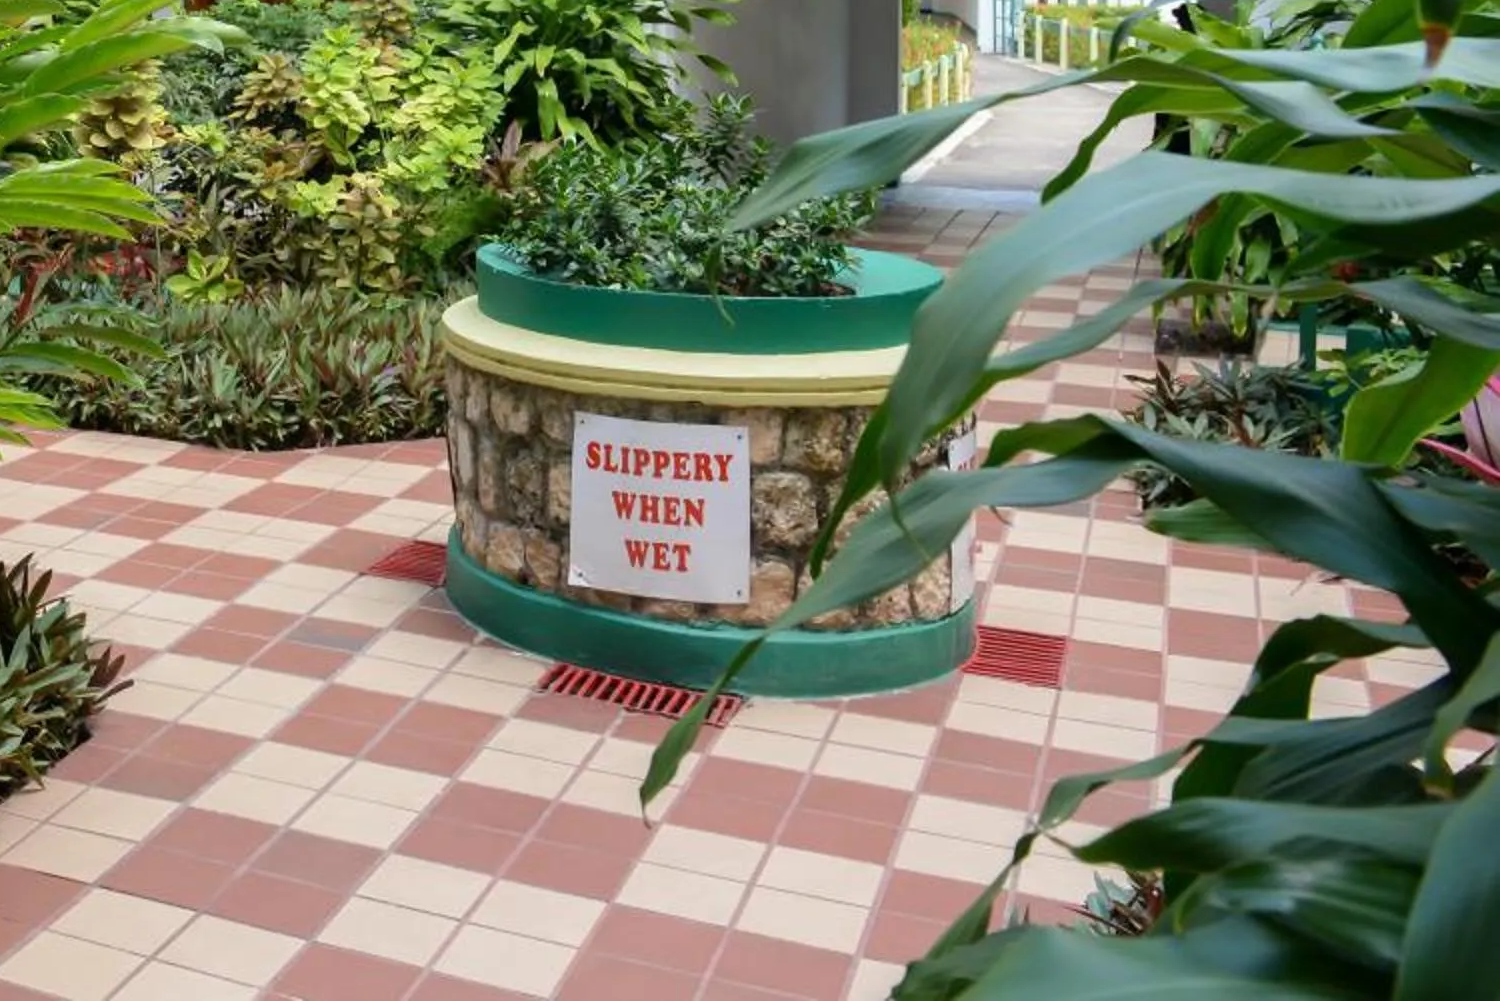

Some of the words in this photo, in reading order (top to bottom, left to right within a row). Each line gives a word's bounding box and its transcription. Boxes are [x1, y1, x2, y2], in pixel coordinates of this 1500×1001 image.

[586, 440, 733, 482] SLIPPERY
[612, 490, 705, 527] WHEN
[625, 539, 692, 573] WET
